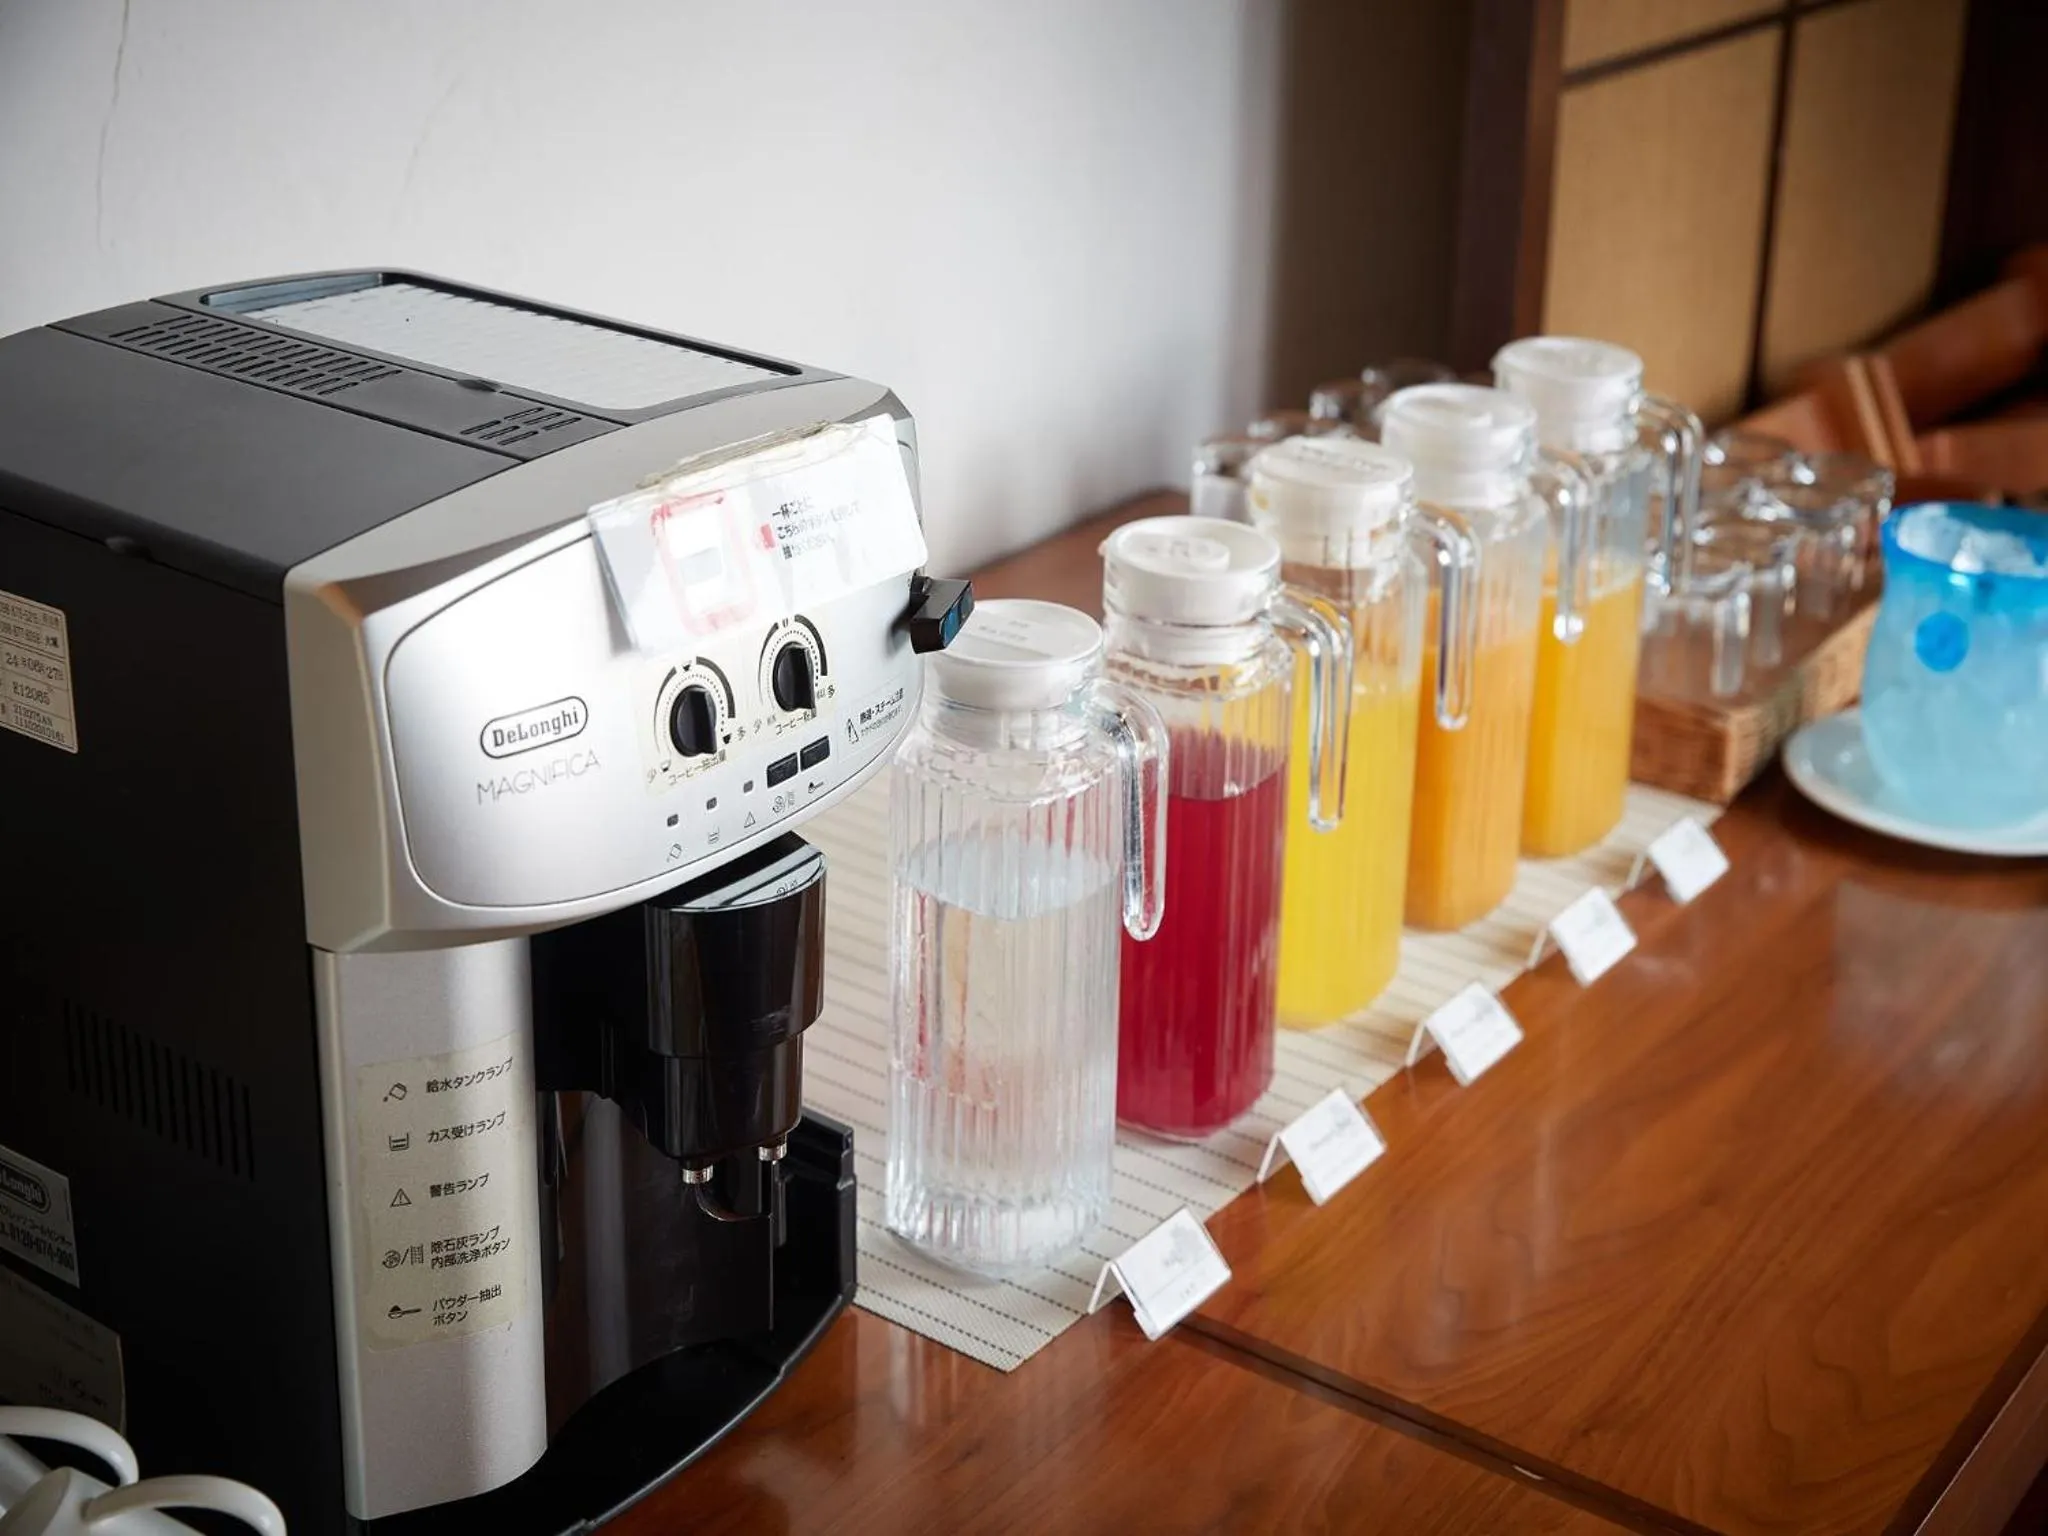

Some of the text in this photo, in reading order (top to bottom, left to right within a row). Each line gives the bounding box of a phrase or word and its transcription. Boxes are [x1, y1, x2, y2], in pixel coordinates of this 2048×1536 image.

[492, 706, 579, 748] DeLonghi
[476, 748, 602, 806] MAGNIFICA
[425, 1056, 513, 1093] 給水タンクランプ
[427, 1110, 506, 1143] カス受けランプ
[429, 1172, 490, 1198] 警告ランプ
[432, 1284, 502, 1312] パウダー抽出
[432, 1310, 468, 1327] ボタン
